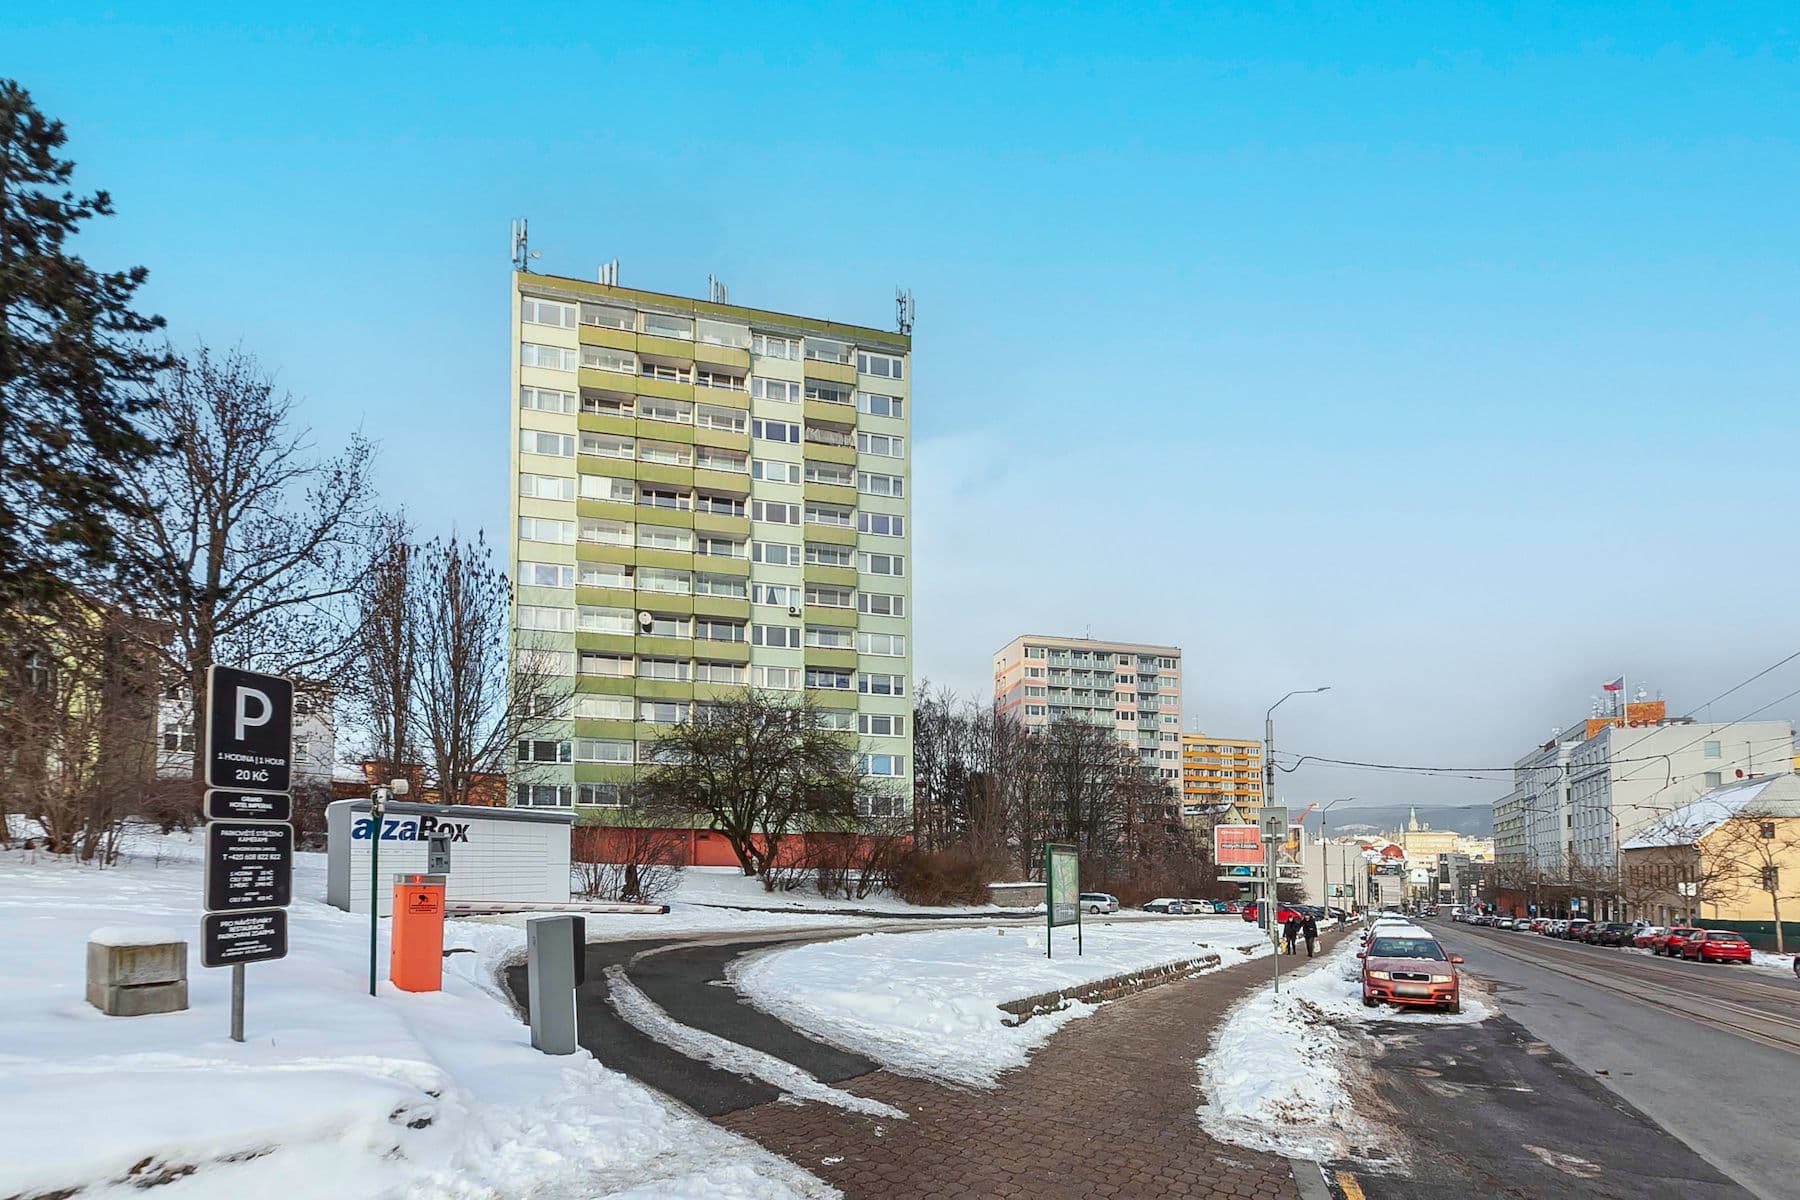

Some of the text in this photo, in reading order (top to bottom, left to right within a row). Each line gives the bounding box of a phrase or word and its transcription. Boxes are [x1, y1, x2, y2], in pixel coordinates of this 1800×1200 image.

[235, 685, 273, 741] P
[265, 757, 286, 766] HOUR
[235, 769, 269, 782] 20 KČ
